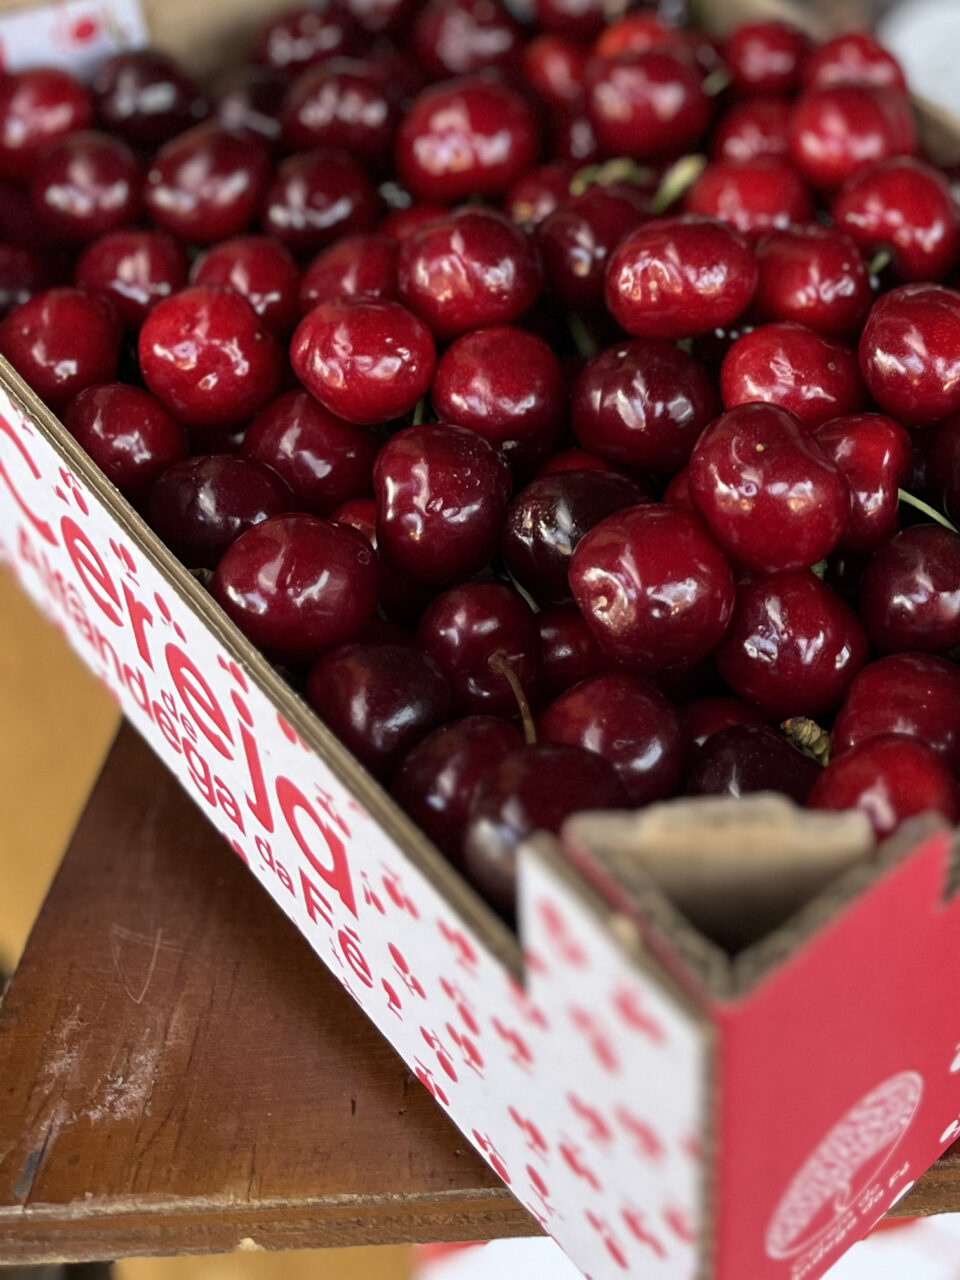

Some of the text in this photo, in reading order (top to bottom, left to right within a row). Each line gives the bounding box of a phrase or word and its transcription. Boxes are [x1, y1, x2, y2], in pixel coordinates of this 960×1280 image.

[161, 689, 198, 744] de
[254, 834, 297, 899] da
[299, 865, 374, 989] Fé
